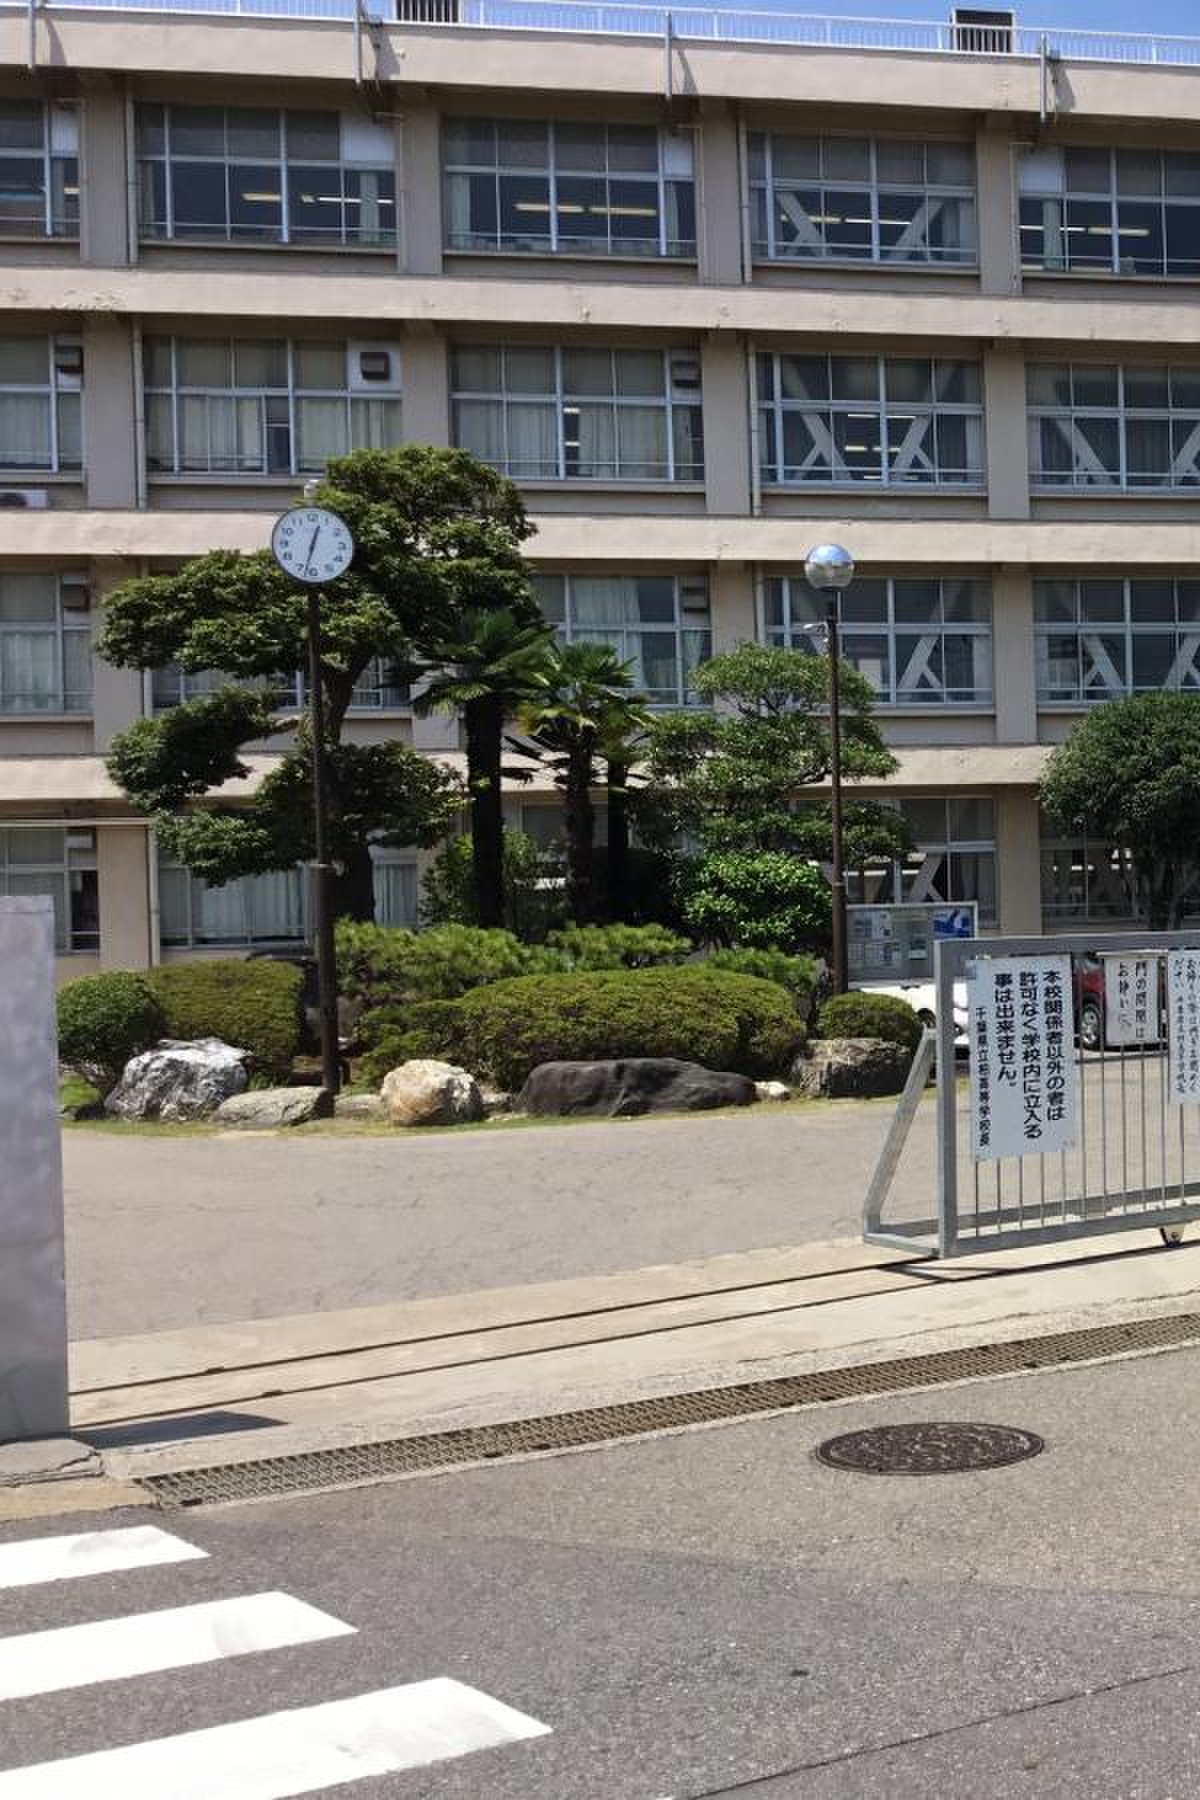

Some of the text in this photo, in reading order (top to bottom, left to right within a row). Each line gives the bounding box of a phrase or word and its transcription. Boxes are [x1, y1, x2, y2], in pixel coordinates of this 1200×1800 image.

[993, 972, 1018, 1088] 事は出来ません。
[1018, 971, 1043, 1140] 許可なく学校内に立入る
[1042, 970, 1066, 1121] 本校関係者以外の者は
